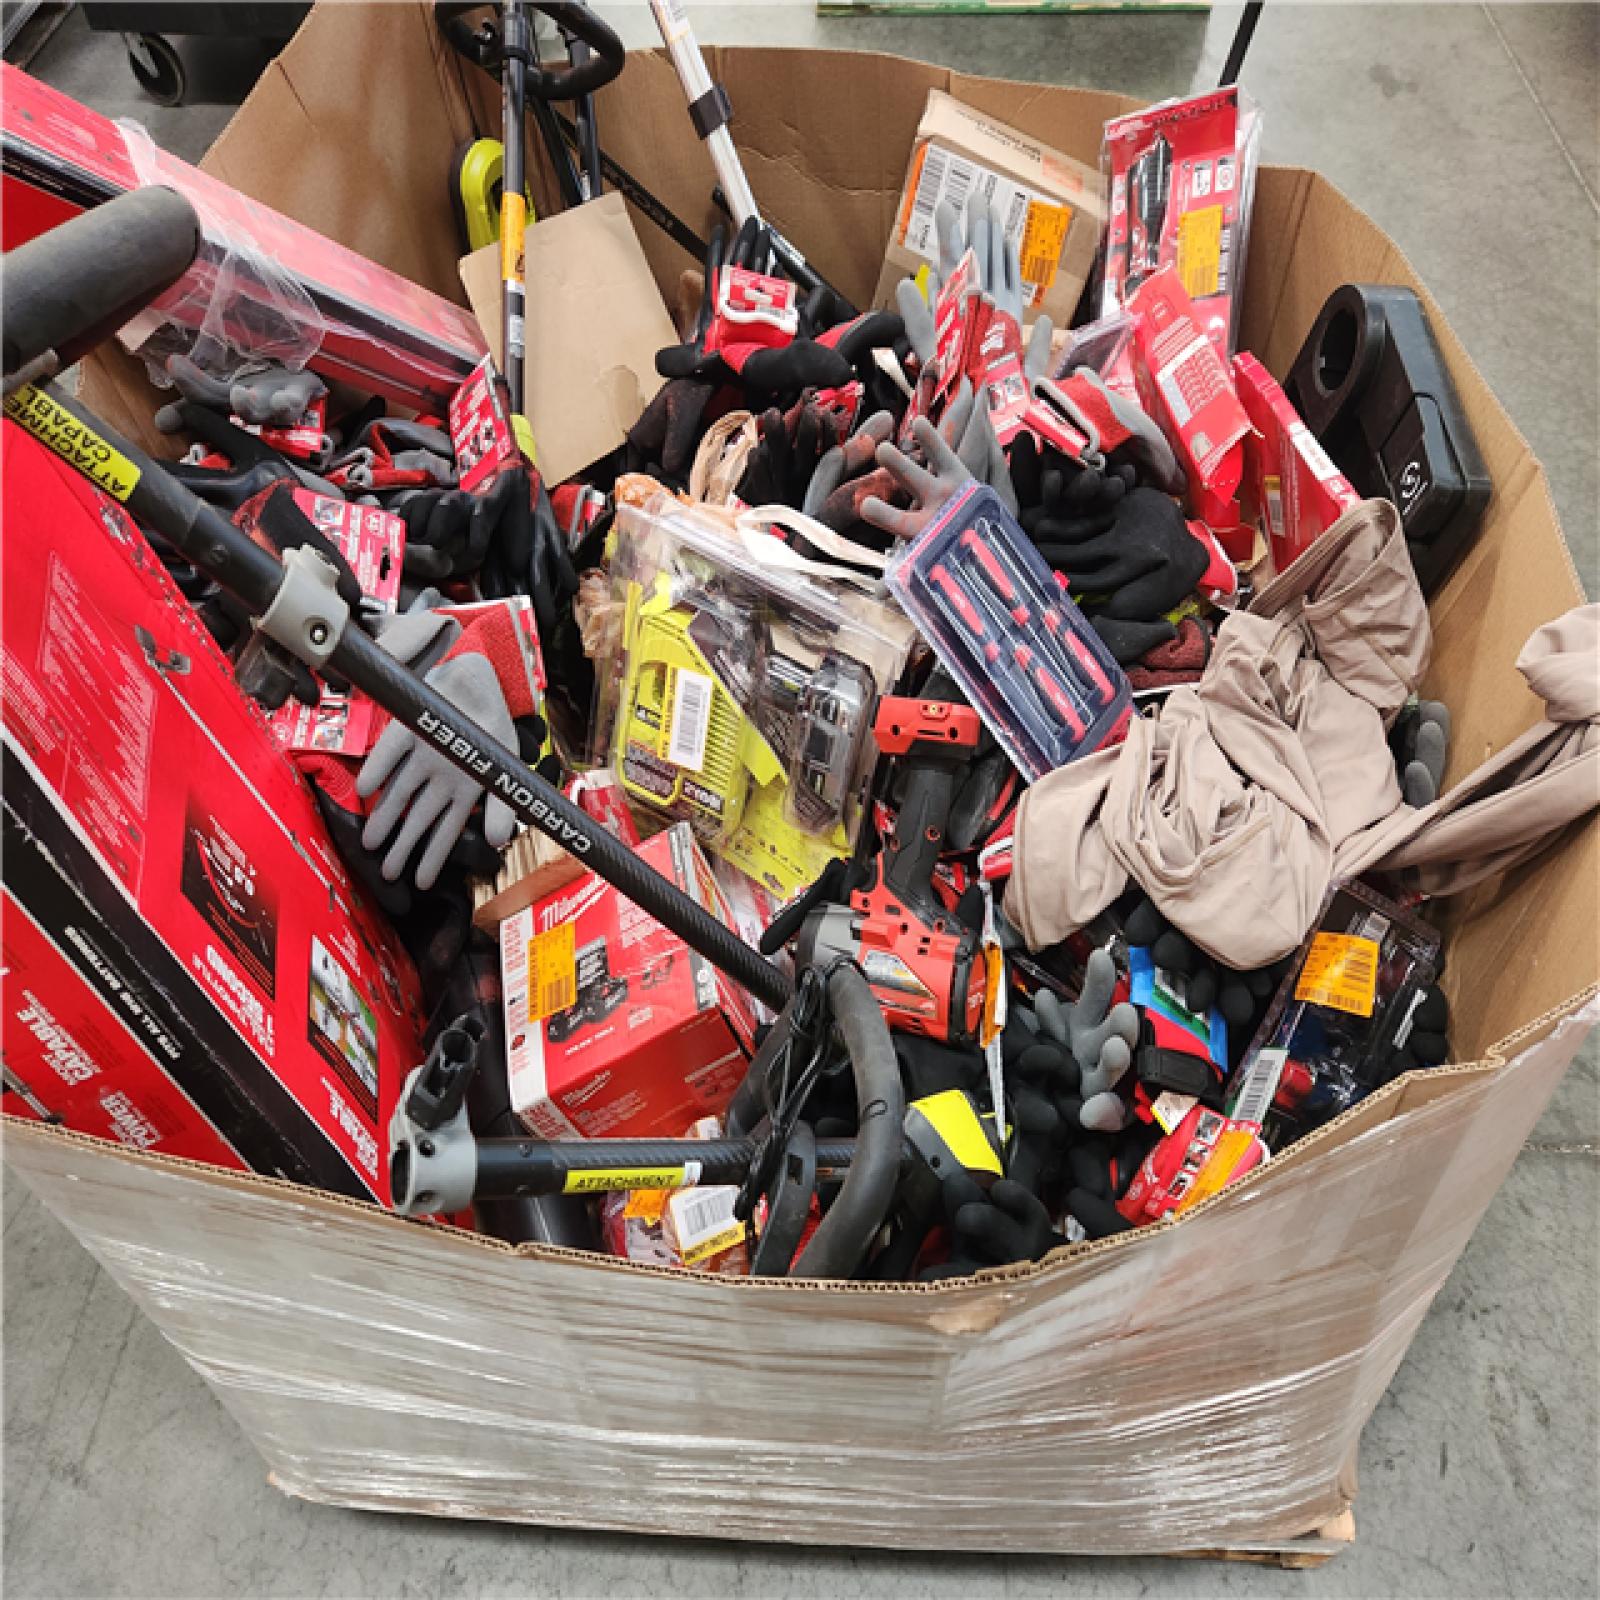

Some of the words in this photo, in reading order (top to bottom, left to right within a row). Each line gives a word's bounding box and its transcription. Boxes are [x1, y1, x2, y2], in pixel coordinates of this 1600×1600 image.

[415, 709, 493, 776] FIBER
[494, 771, 592, 852] CARBON
[575, 1173, 675, 1189] ATTACHMENT
